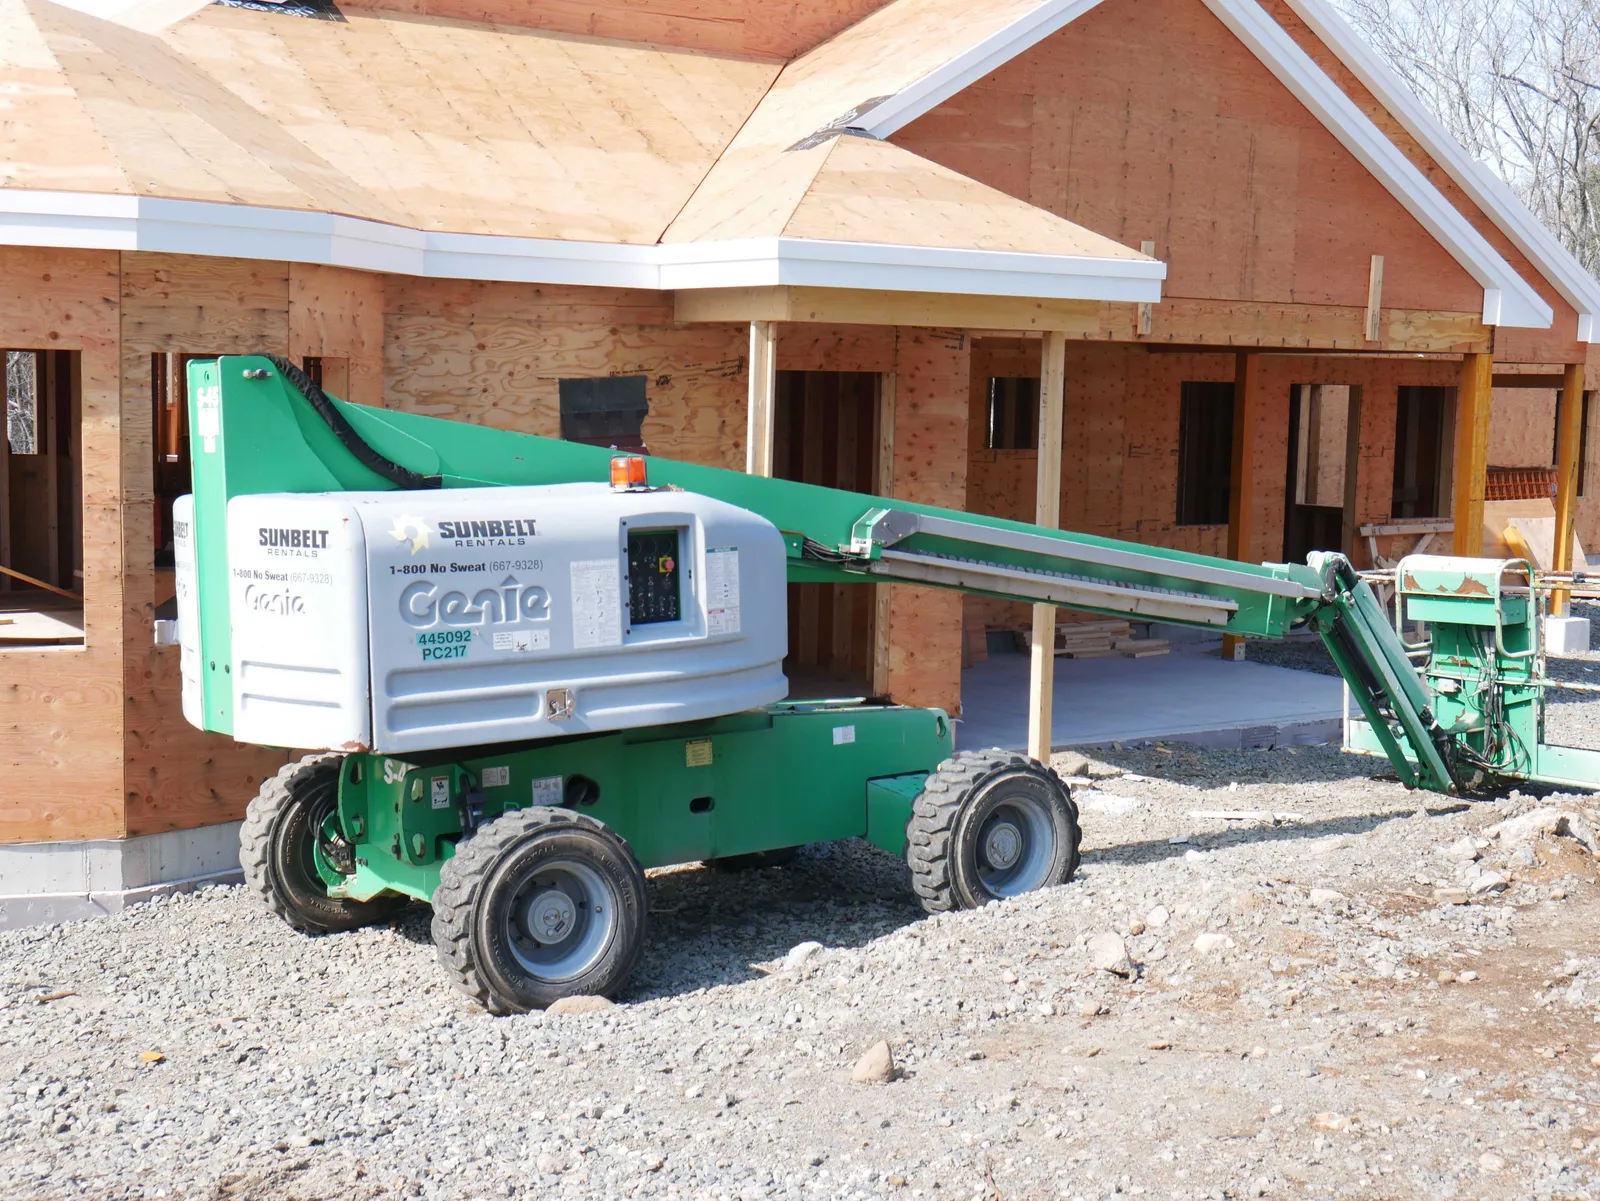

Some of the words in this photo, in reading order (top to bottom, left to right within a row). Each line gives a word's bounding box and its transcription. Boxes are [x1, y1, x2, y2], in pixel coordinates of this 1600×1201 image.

[438, 519, 537, 539] SUNBELT
[259, 527, 329, 549] SUNBELT
[455, 538, 526, 547] RENTALS
[267, 548, 318, 558] RENTALS
[389, 564, 427, 575] 1-800
[430, 563, 447, 574] No
[449, 562, 486, 573] Sweat
[489, 560, 544, 573] (667-9328)
[233, 568, 251, 579] 1-800
[253, 570, 263, 580] No
[264, 571, 289, 582] Sweat
[290, 573, 333, 586] (667-9328)
[399, 574, 551, 630] Genie
[418, 630, 472, 646] 445092
[422, 645, 467, 661] PC217
